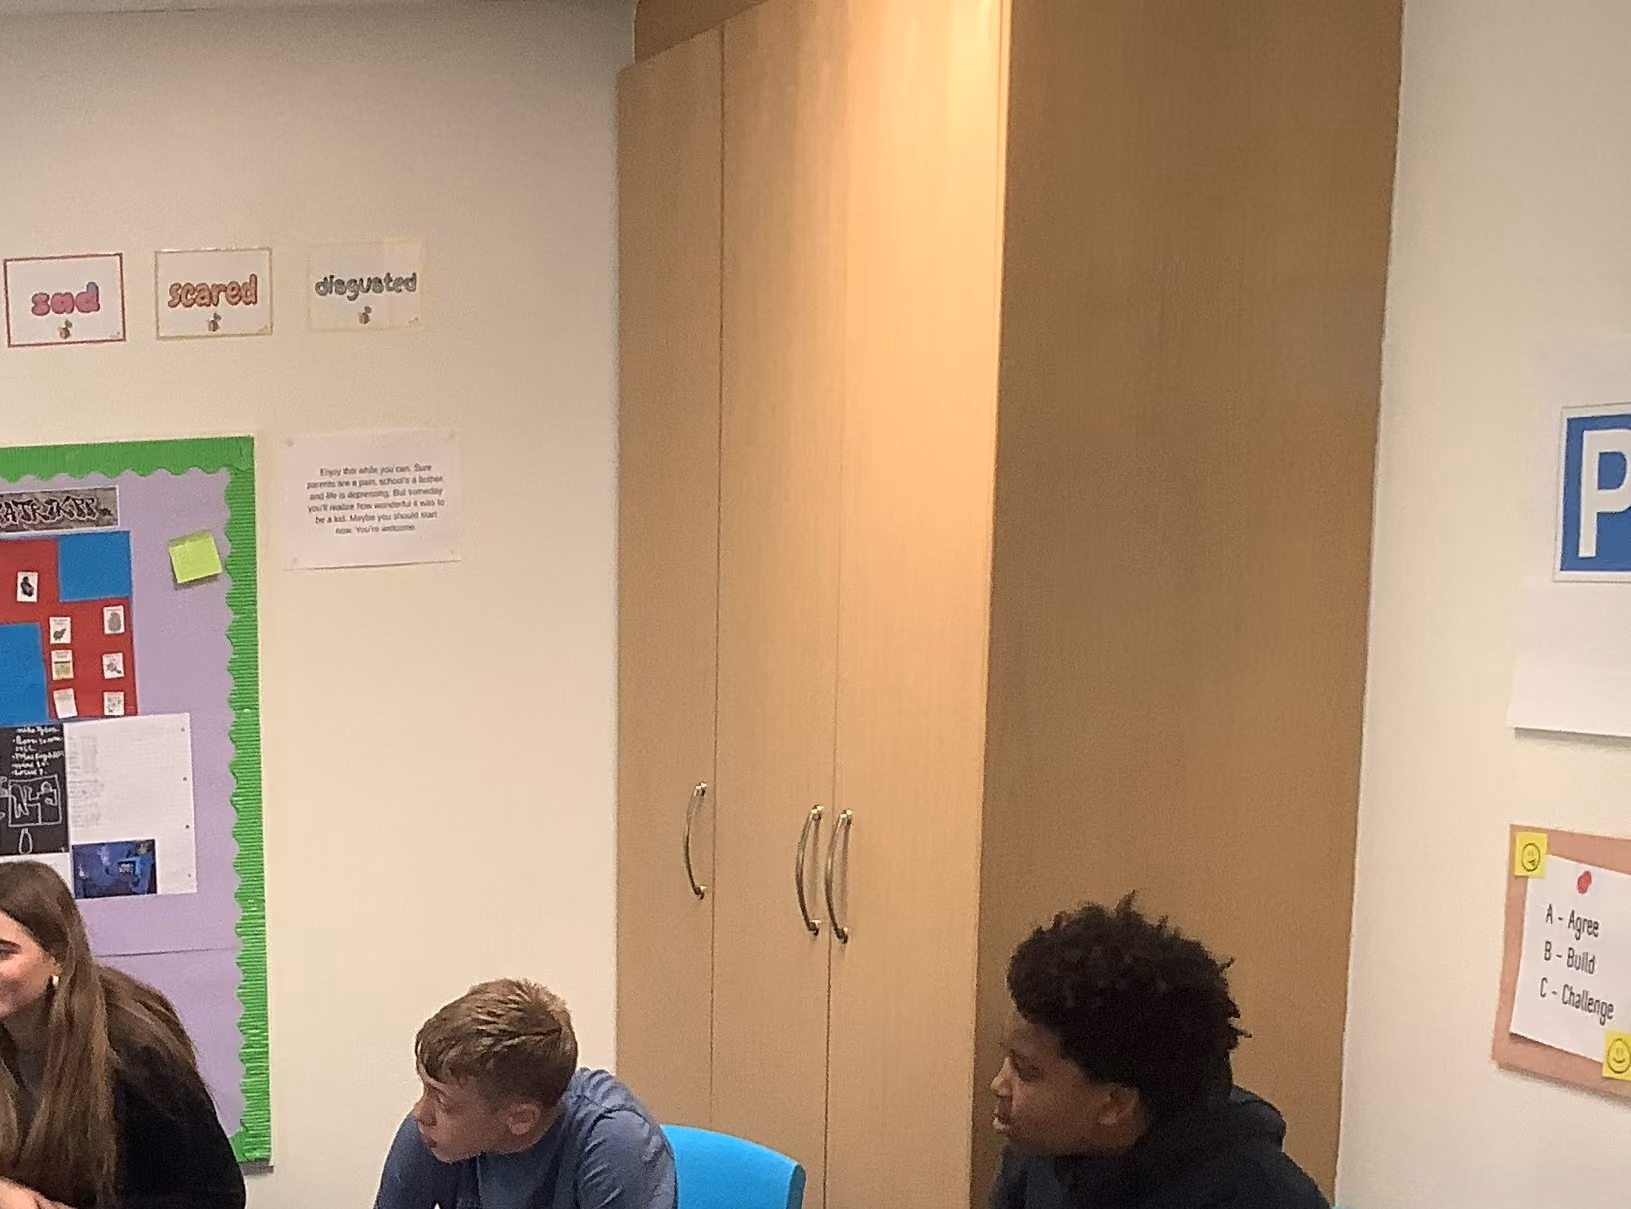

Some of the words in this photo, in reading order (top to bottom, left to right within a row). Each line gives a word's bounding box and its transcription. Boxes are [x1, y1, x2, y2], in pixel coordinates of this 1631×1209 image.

[32, 282, 100, 316] sad
[168, 273, 257, 308] scared
[314, 272, 417, 301] disgusted
[1578, 428, 1631, 558] P
[1545, 904, 1553, 925] A
[1567, 909, 1599, 940] Agree
[1543, 941, 1552, 961] B
[1566, 947, 1596, 975] Build
[1539, 977, 1548, 998] C
[1561, 984, 1614, 1026] Challenge
